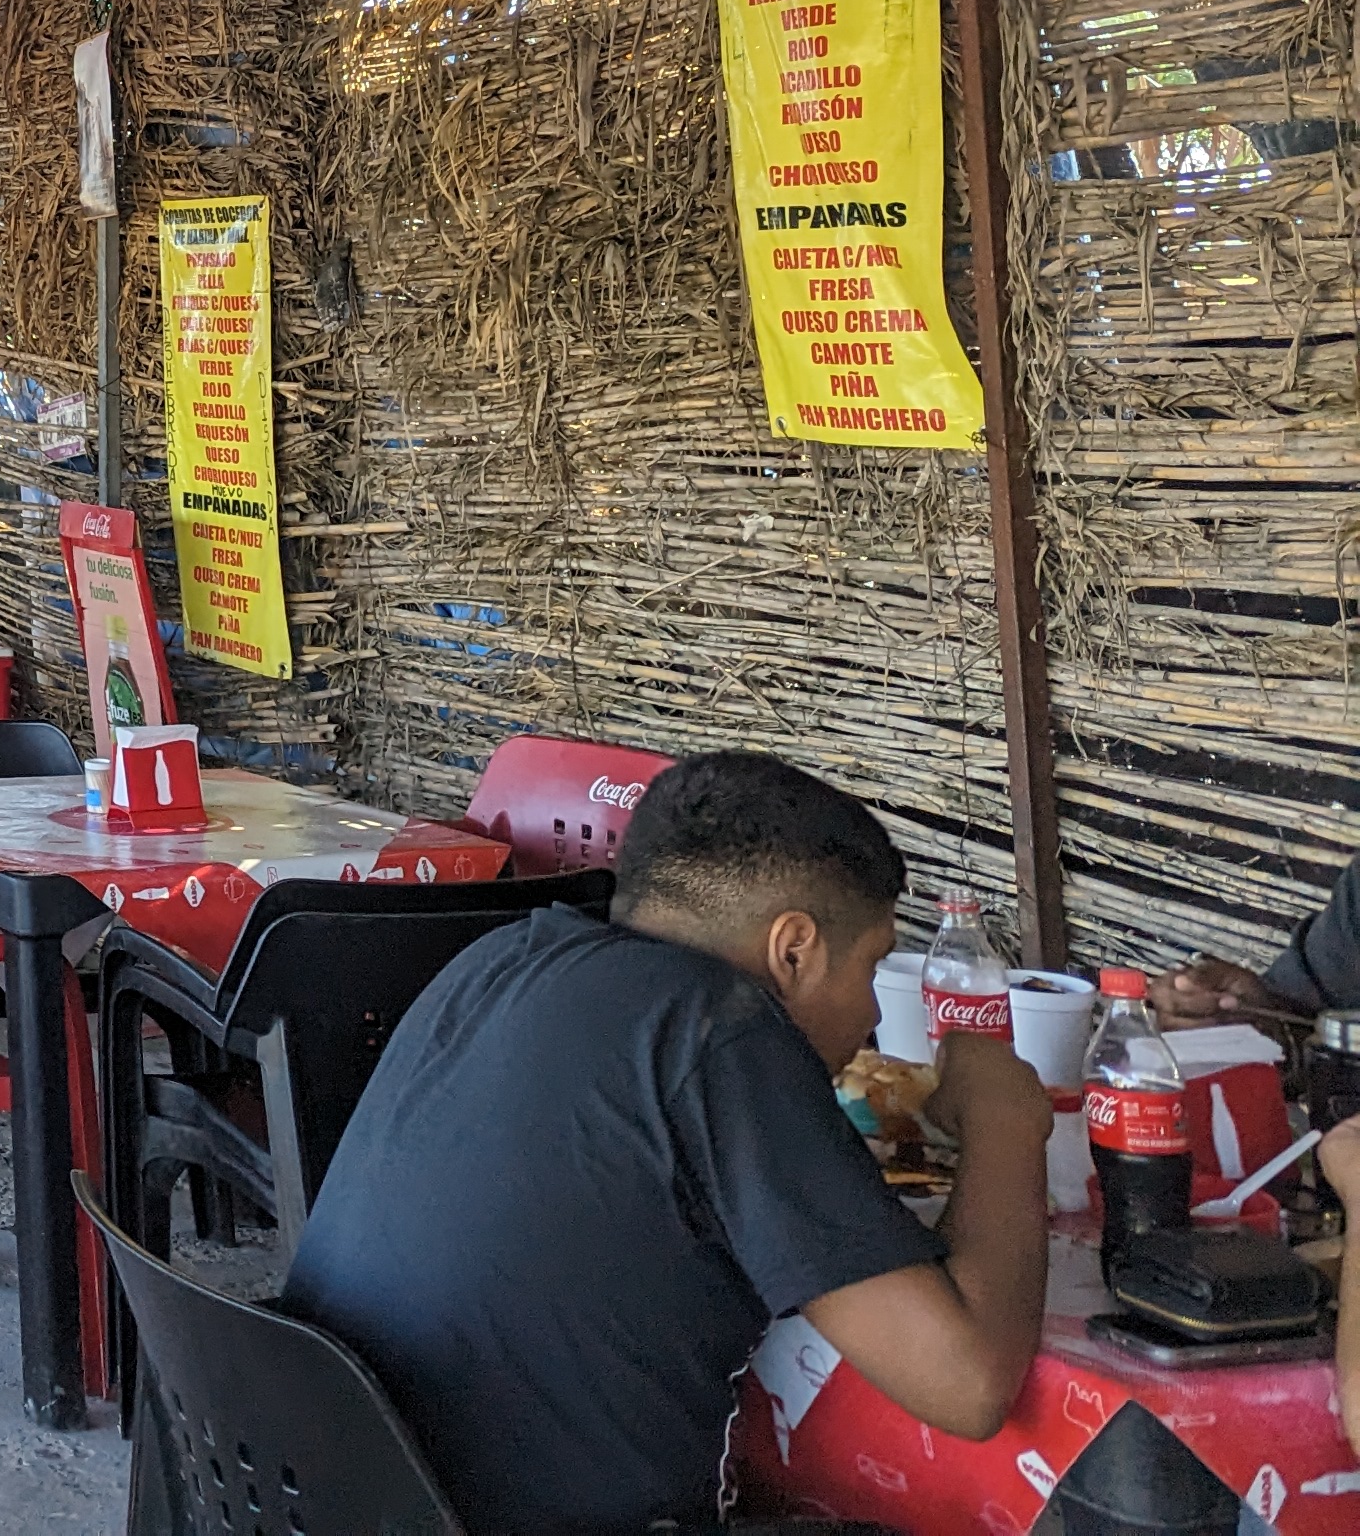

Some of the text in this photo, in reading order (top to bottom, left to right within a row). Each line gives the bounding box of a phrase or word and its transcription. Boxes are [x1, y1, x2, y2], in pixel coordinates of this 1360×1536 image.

[781, 3, 836, 31] VERDE
[788, 36, 828, 61] ROJO
[203, 207, 215, 223] DE
[756, 202, 907, 230] EMPANADAS
[773, 244, 903, 270] CAJETA C/NUEZ
[198, 274, 225, 289] PELLA
[809, 277, 875, 301] FRESA
[211, 295, 259, 312] C/QUESO
[205, 317, 253, 334] C/QUESO
[781, 309, 929, 334] QUESO CREMA
[811, 342, 894, 365] CAMOTE
[198, 360, 234, 376] VERDE
[202, 381, 232, 398] ROJO
[830, 371, 879, 398] PIÑA
[193, 402, 246, 421] PICADILLO
[796, 403, 946, 432] PAN RANCHERO
[195, 421, 250, 443] REQUESÓN
[205, 445, 240, 464] QUESO
[194, 465, 257, 489] CHORIQUESO
[182, 492, 268, 522] EMPANADAS
[83, 511, 112, 539] Coca-Cola
[192, 522, 263, 549] CAJETA C/NUEZ
[86, 556, 134, 581] tu deliciosa
[212, 547, 244, 568] FRESA
[193, 565, 261, 594] QUESO CREMA
[210, 591, 249, 614] CAMOTE
[190, 629, 263, 664] PAN RANCHERO
[589, 775, 647, 810] Coca-Co
[938, 997, 1008, 1026] Coca-Cola
